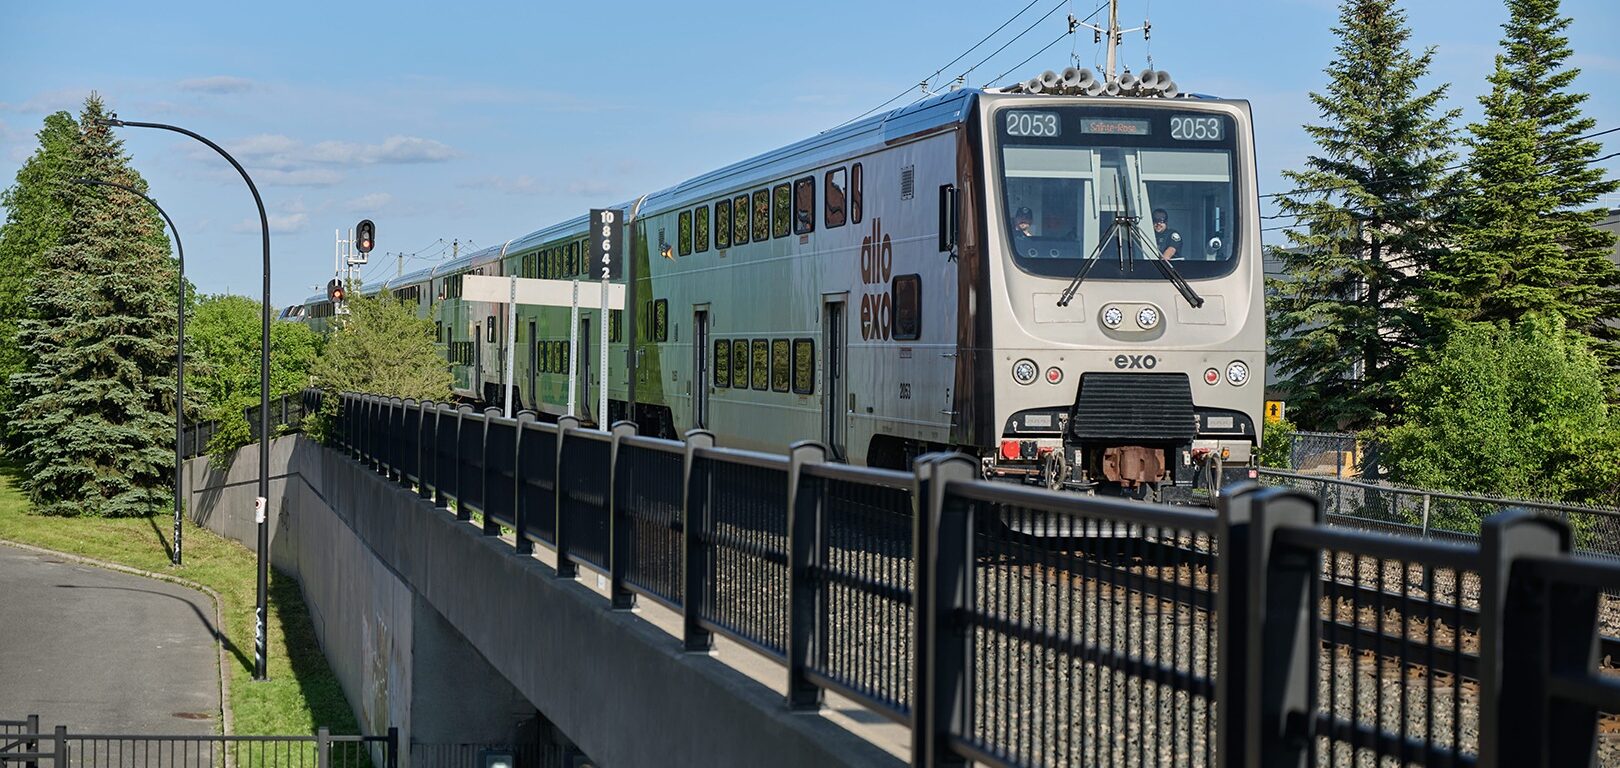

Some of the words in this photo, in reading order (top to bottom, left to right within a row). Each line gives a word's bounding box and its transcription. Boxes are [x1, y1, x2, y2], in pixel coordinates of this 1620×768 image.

[1006, 113, 1057, 137] 2053
[1090, 122, 1137, 133] Sainte-Rose
[1170, 117, 1219, 139] 2053
[600, 211, 614, 224] 10
[602, 225, 611, 238] 8
[602, 239, 611, 251] 6
[861, 217, 892, 285] allo
[601, 253, 611, 265] 4
[601, 267, 610, 279] 2
[861, 291, 892, 342] exo
[1114, 354, 1157, 369] exo
[899, 382, 911, 399] 2053
